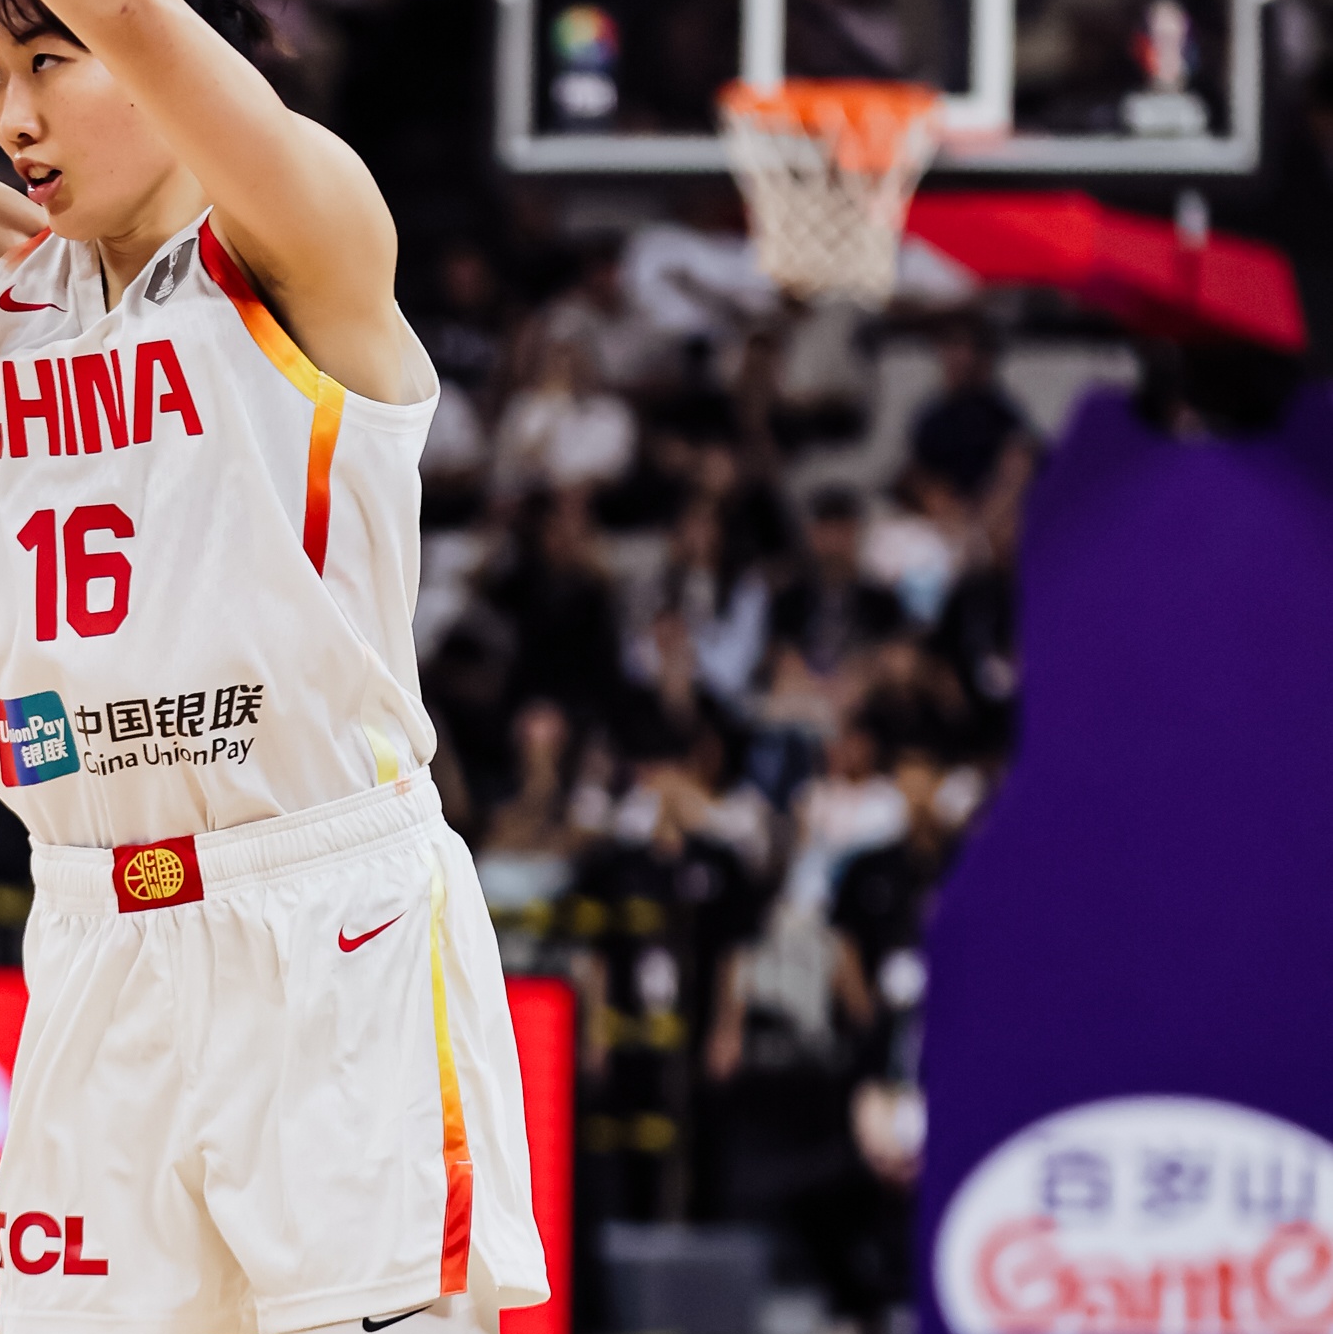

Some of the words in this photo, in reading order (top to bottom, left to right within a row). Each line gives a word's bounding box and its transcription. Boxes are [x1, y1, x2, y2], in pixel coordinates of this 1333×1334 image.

[16, 503, 135, 642] 16
[73, 684, 265, 747] 中国银联
[20, 738, 69, 769] 银联
[83, 750, 139, 776] Cina
[143, 849, 164, 899] CHN
